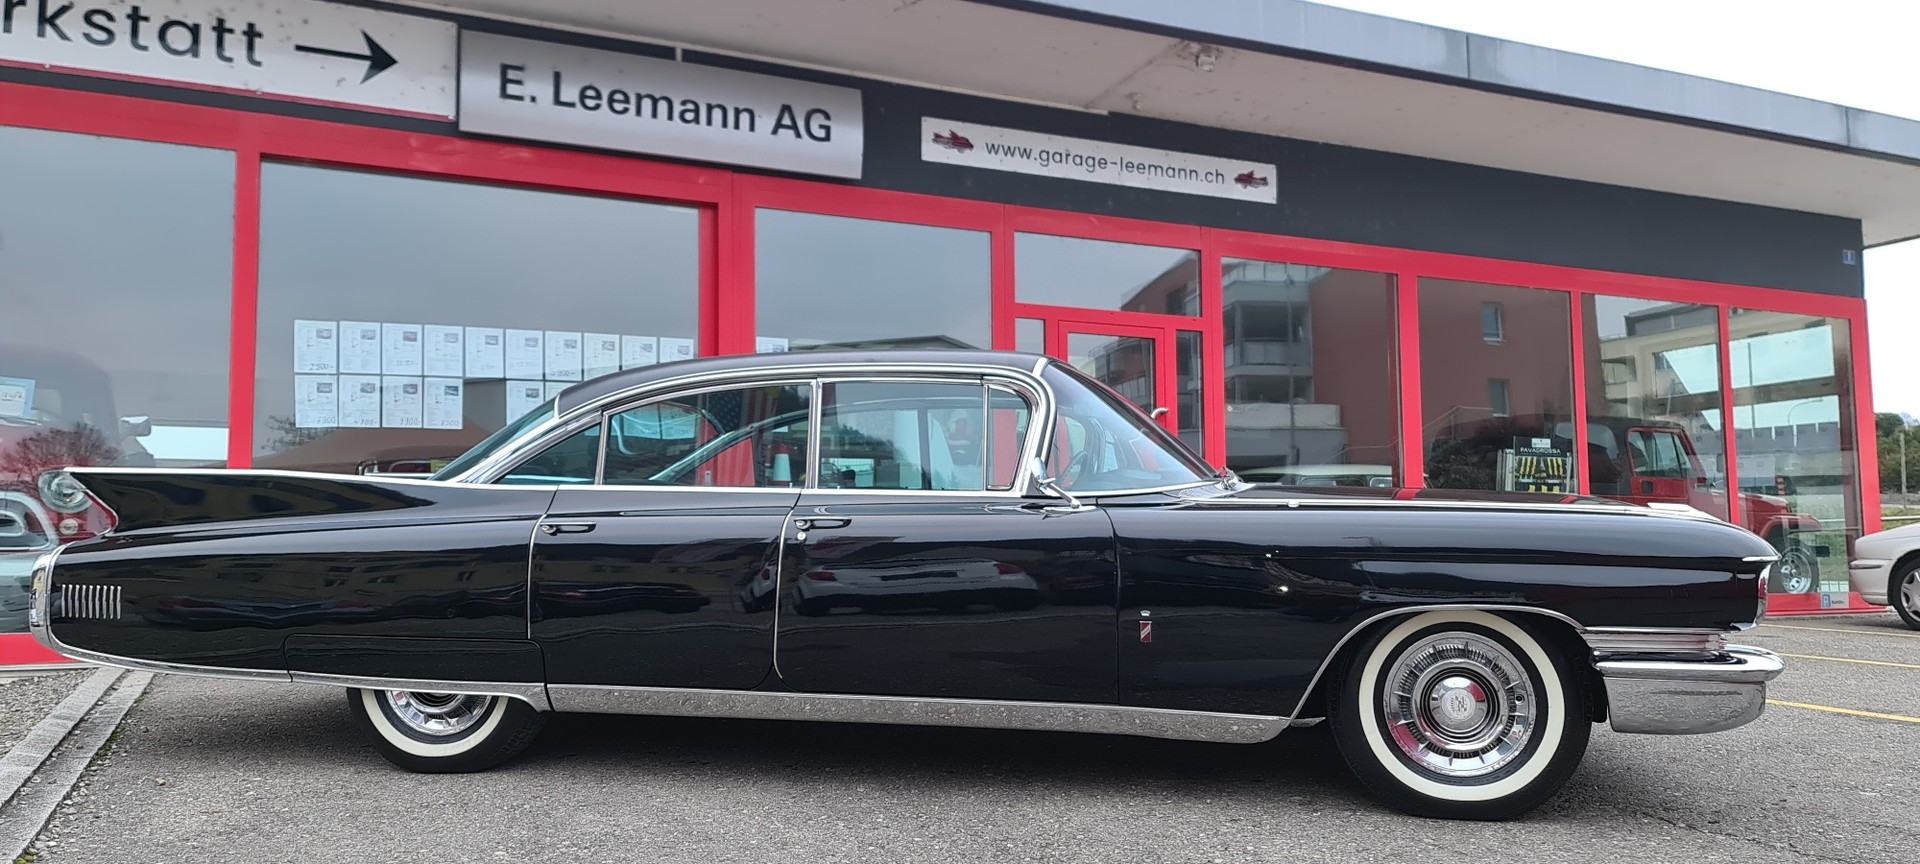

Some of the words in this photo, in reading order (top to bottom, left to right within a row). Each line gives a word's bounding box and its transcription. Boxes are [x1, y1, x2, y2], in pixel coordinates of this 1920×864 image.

[499, 64, 536, 102] E.
[553, 70, 755, 132] Leemann
[771, 103, 832, 142] AG
[985, 142, 1225, 184] www.garage-leemann.ch
